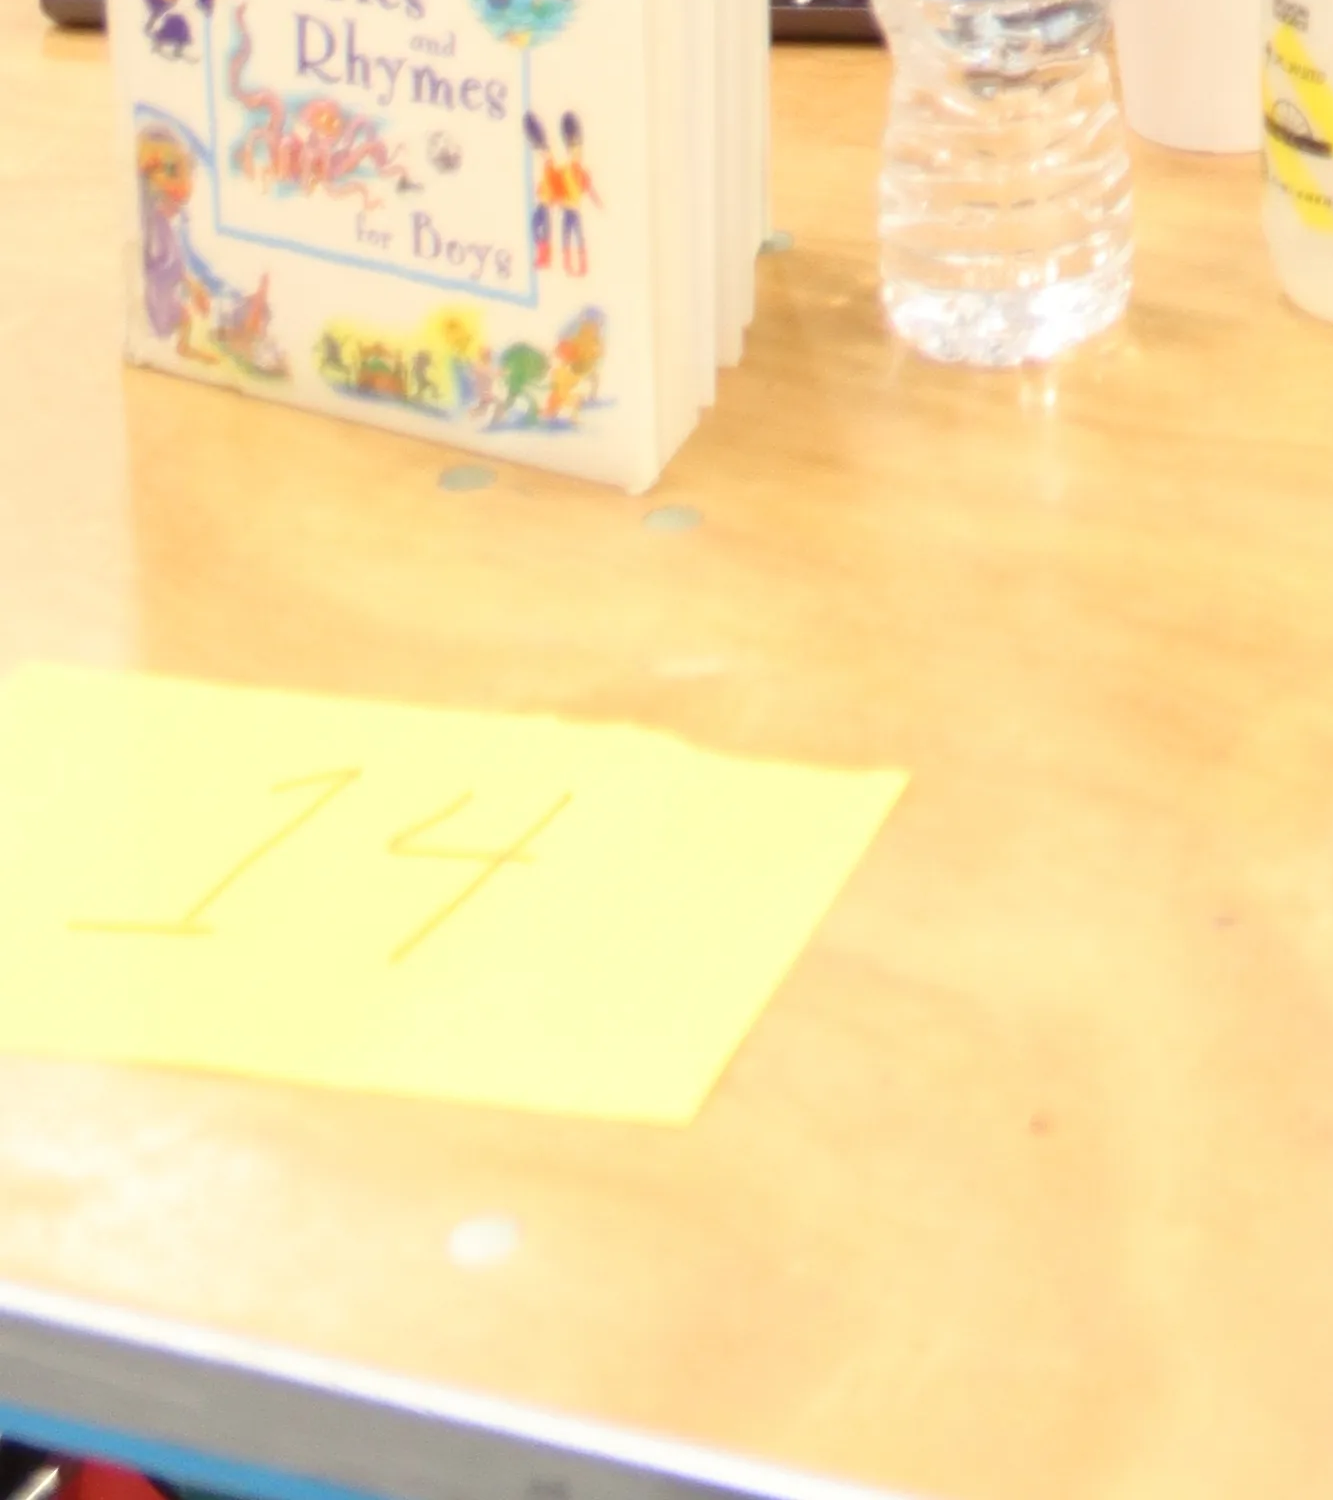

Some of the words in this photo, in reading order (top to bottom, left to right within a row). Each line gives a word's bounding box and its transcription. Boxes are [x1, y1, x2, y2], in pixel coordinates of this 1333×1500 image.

[293, 11, 508, 120] Rhymes
[410, 31, 456, 57] and
[412, 210, 512, 281] Boys
[66, 764, 575, 967] 14
